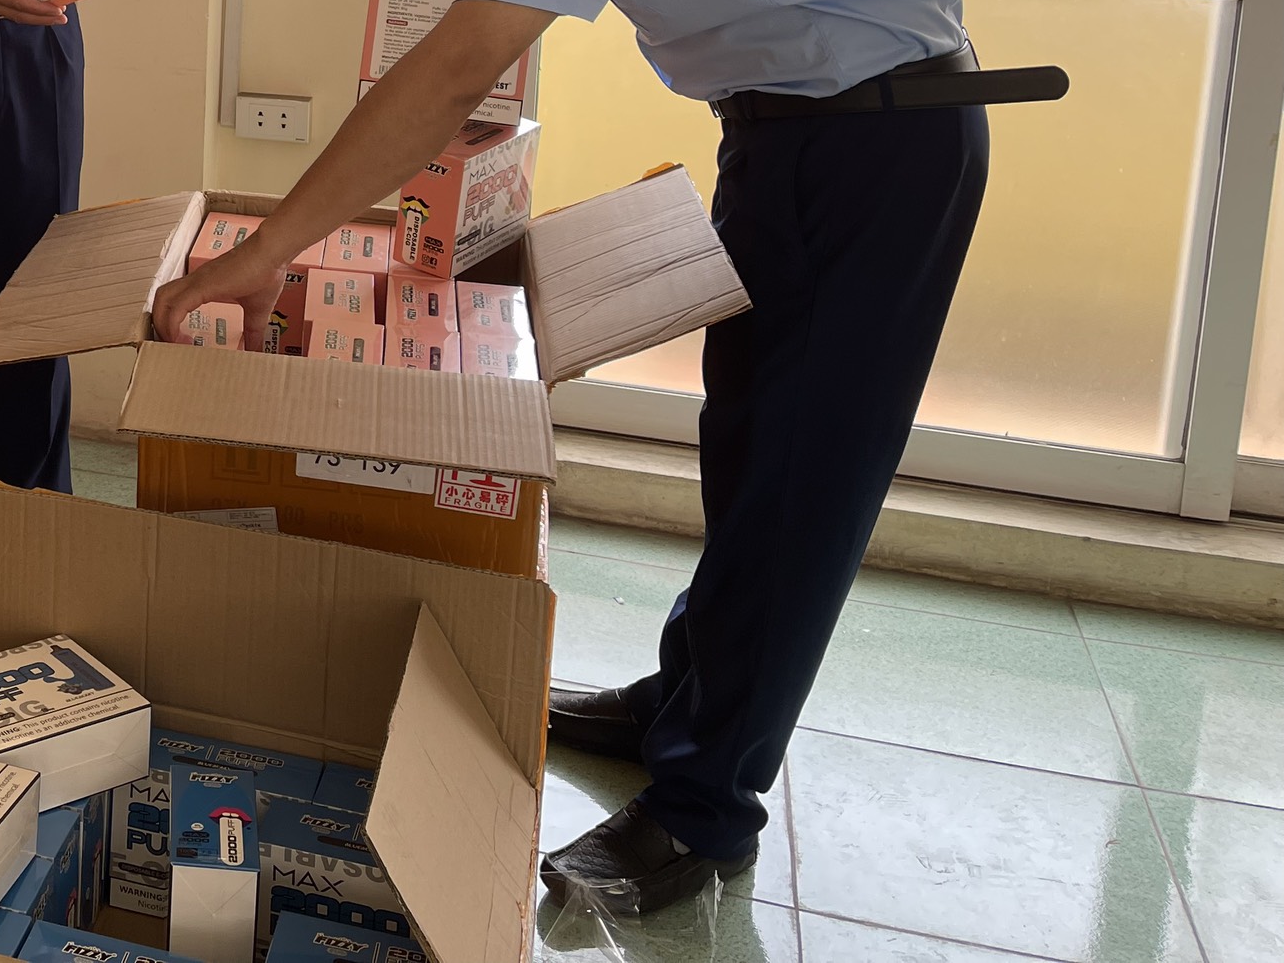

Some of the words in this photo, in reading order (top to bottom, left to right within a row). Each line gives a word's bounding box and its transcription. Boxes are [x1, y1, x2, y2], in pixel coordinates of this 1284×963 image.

[482, 101, 511, 110] nicotine.
[469, 159, 497, 184] MAX
[465, 163, 518, 208] 2000
[463, 194, 496, 226] PUFF
[405, 226, 413, 246] E-CIG
[409, 216, 420, 261] DISPOSABLE
[473, 291, 485, 309] 2000
[325, 329, 338, 349] 2000
[401, 338, 414, 358] 2000
[477, 344, 490, 365] 2000
[444, 496, 509, 514] FRAGILE
[445, 485, 510, 507] 小心易碎
[23, 721, 40, 730] This
[40, 712, 69, 725] product
[69, 704, 101, 716] contains
[1, 729, 35, 743] Nicotine
[54, 714, 87, 729] addictive
[158, 738, 204, 753] FIZZY
[218, 748, 284, 768] 2000
[215, 754, 267, 771] PUFFS
[189, 773, 238, 785] FIZZY
[129, 783, 170, 803] MA
[227, 819, 236, 836] PUFF
[300, 815, 350, 832] FIZZY
[127, 828, 170, 857] PU
[228, 836, 238, 863] 2000
[122, 865, 153, 877] DISPOSABLE
[272, 864, 345, 898] MAX
[119, 885, 166, 904] WARNING:
[271, 885, 410, 937] 2000
[61, 941, 118, 963] FIZZY
[313, 933, 369, 954] FIZZY
[387, 947, 428, 963] 20
